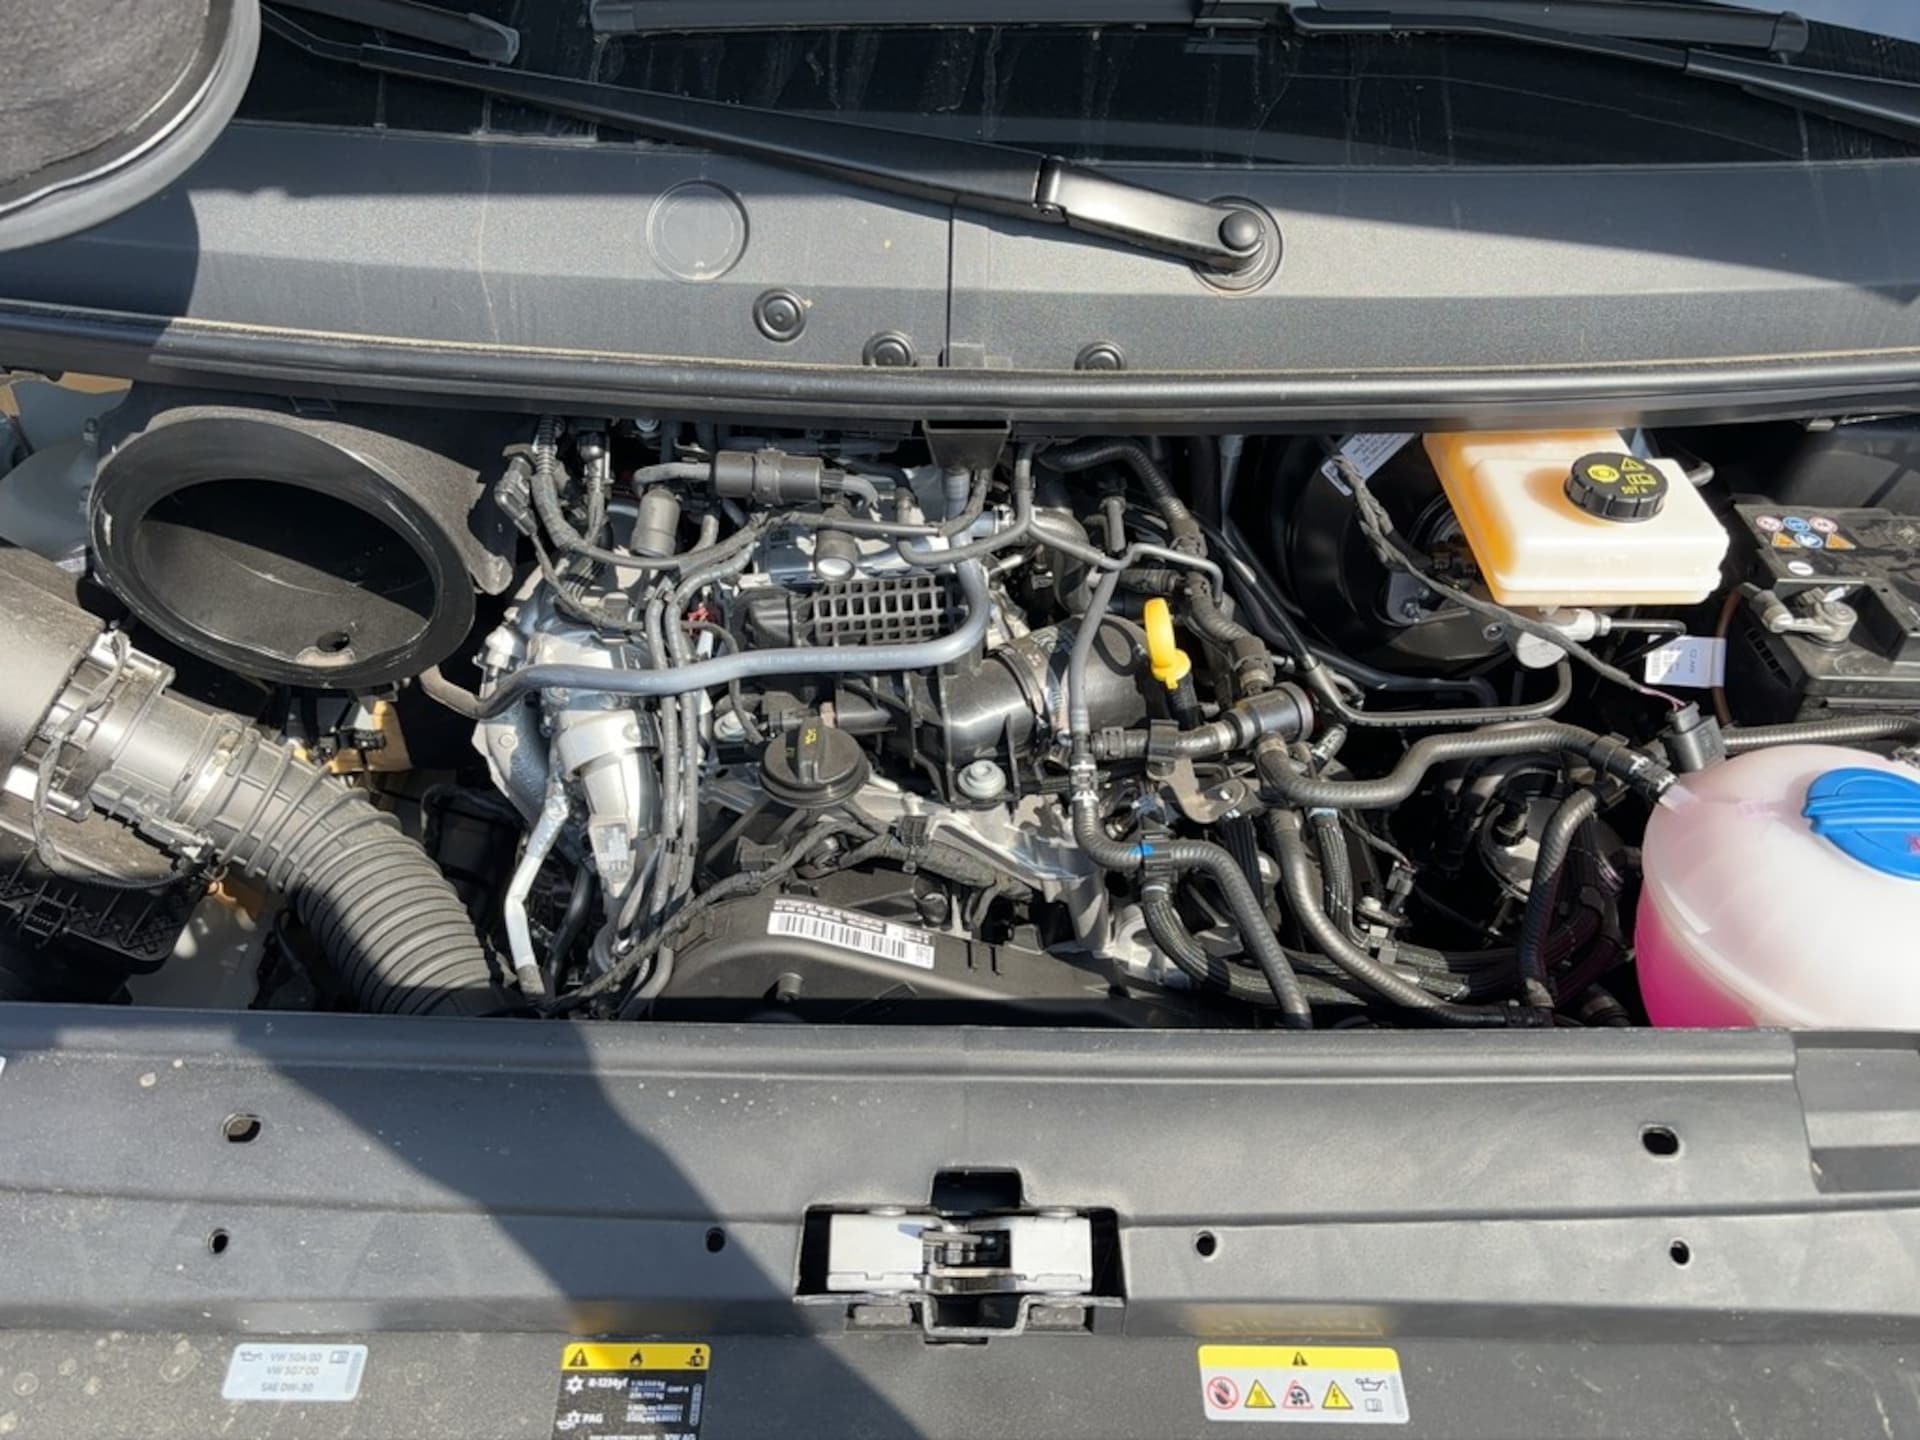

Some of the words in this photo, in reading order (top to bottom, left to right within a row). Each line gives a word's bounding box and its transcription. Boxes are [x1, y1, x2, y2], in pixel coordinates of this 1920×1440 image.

[270, 1352, 288, 1361] VW
[288, 1352, 307, 1362] 504
[266, 1366, 283, 1376] VW
[284, 1366, 304, 1376] 507
[304, 1366, 320, 1376] 00
[261, 1382, 279, 1392] SAE
